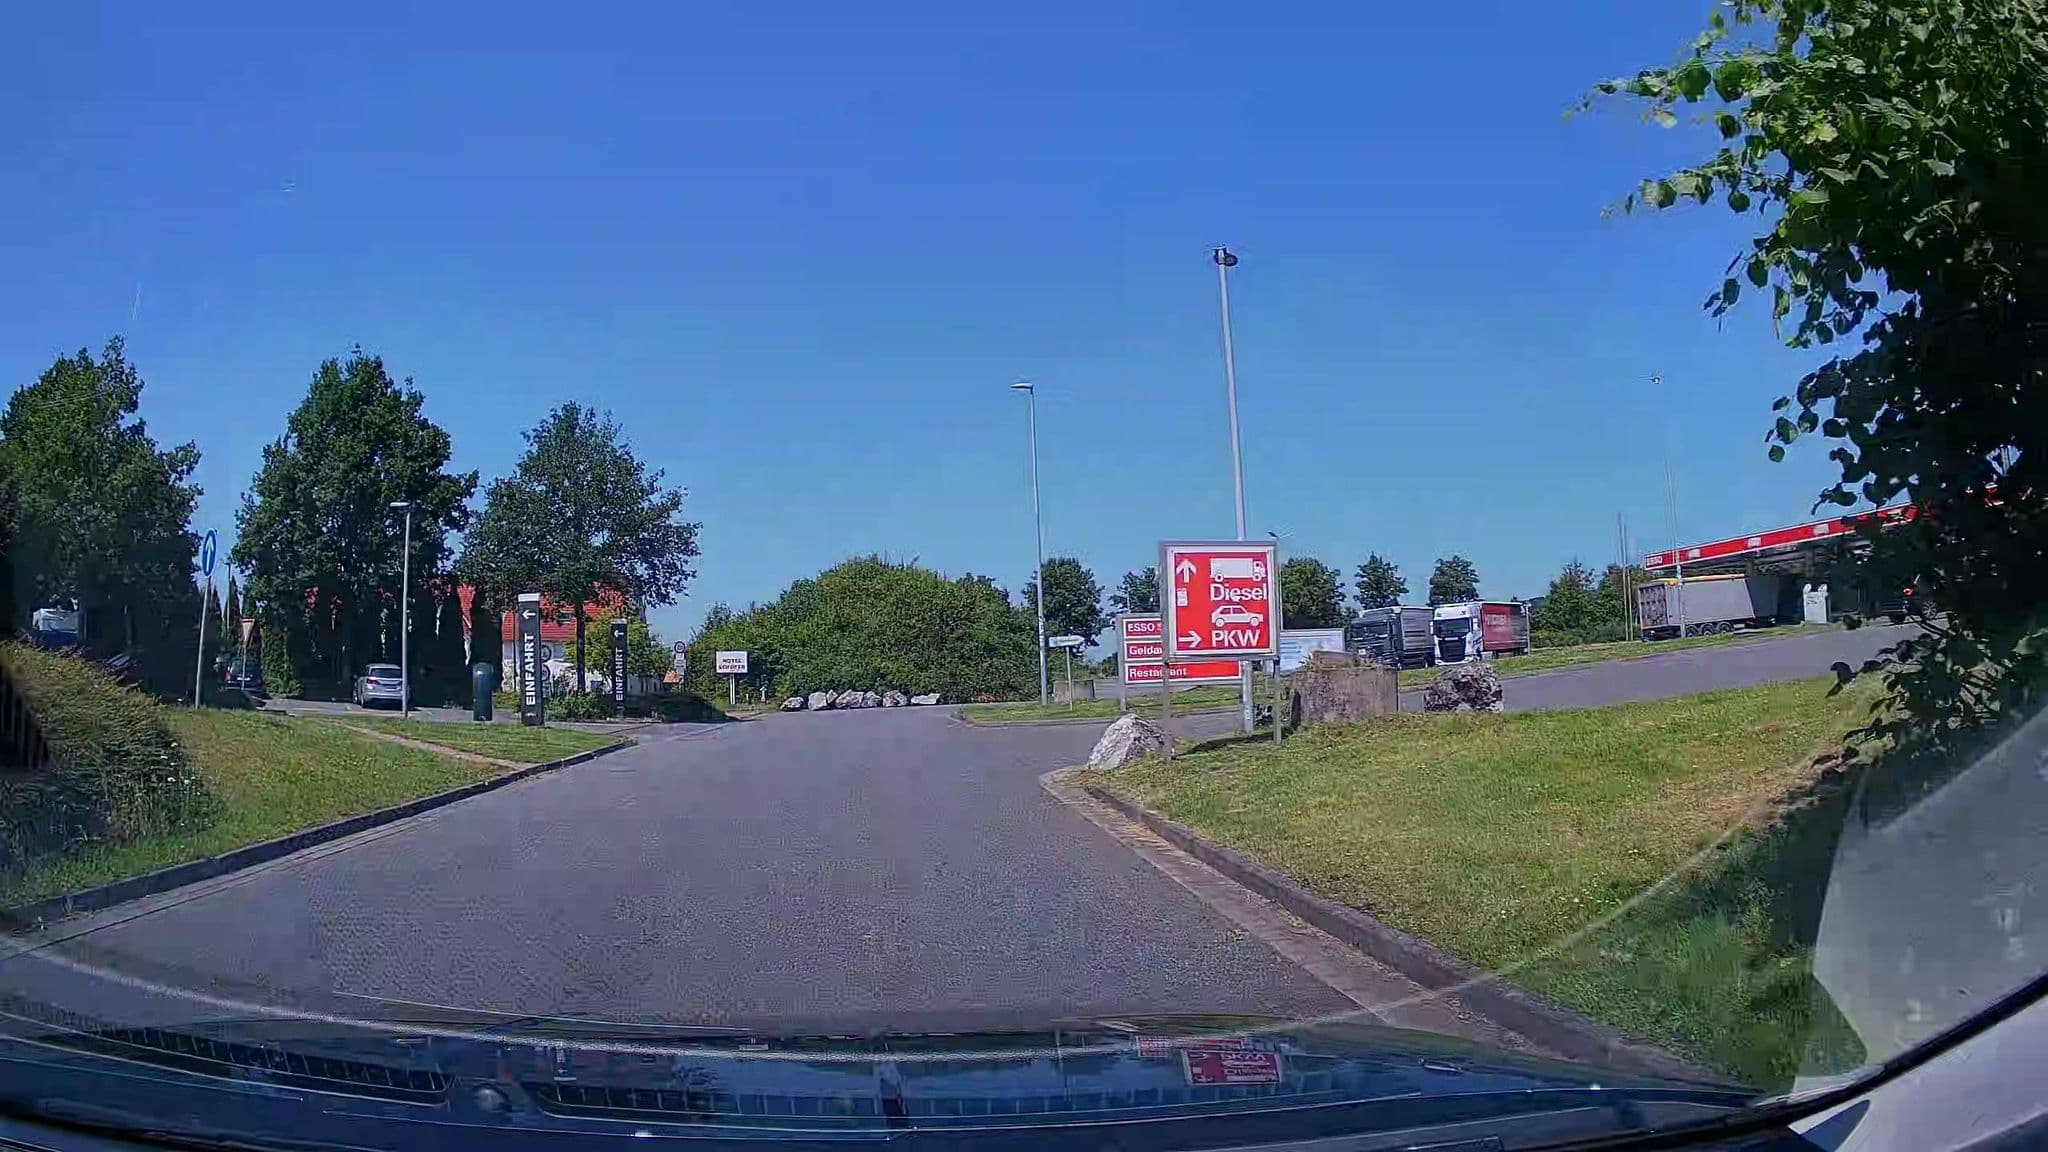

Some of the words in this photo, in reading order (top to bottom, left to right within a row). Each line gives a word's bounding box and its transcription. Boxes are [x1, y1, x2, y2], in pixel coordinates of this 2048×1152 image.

[1210, 583, 1267, 601] Diesel
[1128, 623, 1155, 632] ESSO
[1211, 629, 1261, 647] PKW
[524, 633, 536, 705] EINFAHRT
[615, 648, 624, 701] EINFAHRT
